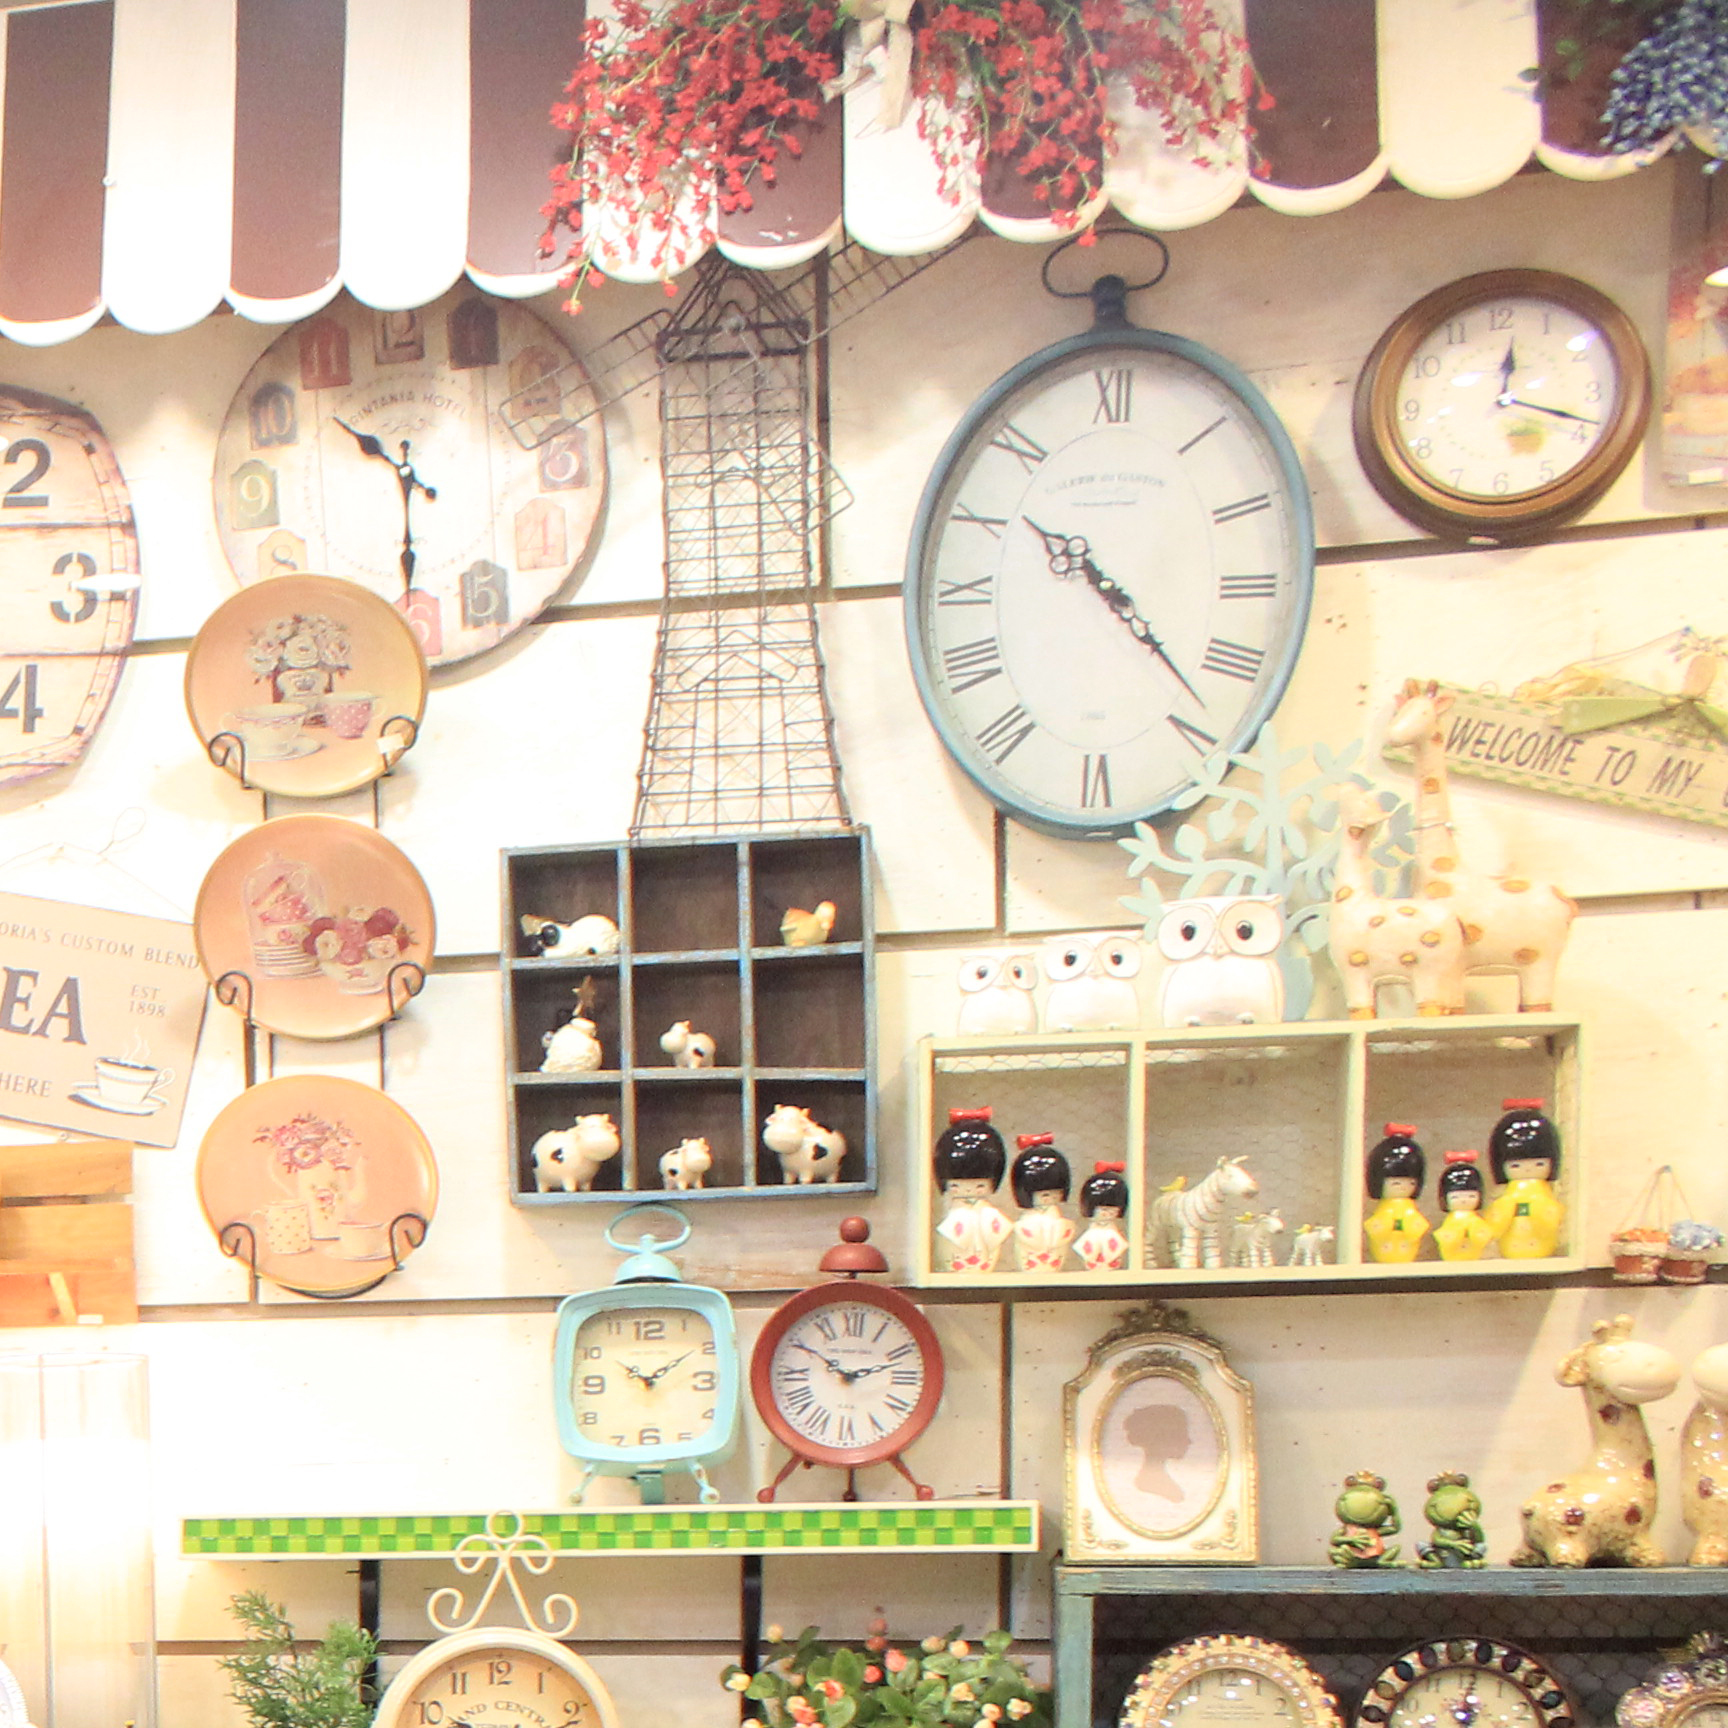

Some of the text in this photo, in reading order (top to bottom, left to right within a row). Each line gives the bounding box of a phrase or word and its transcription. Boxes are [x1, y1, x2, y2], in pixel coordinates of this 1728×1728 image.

[1487, 308, 1515, 331] 12
[1542, 313, 1551, 335] 1
[1446, 322, 1467, 344] 11
[311, 341, 339, 379] 11
[1414, 356, 1441, 379] 10
[1093, 369, 1133, 424] XII
[1585, 381, 1601, 403] 3
[257, 396, 292, 440] 10
[1405, 400, 1420, 421] 9
[1178, 417, 1227, 455] I
[1571, 423, 1588, 444] 4
[991, 423, 1048, 475] XI
[1416, 438, 1433, 459] 8
[545, 440, 580, 482] 3
[1539, 460, 1554, 482] 5
[2, 439, 52, 508] 2
[1449, 468, 1465, 489] 7
[1493, 472, 1509, 495] 6
[241, 475, 270, 517] 9
[951, 503, 1008, 538] X
[1212, 493, 1271, 524] II
[521, 513, 558, 557] 4
[50, 552, 97, 623] 3
[468, 573, 499, 617] 5
[937, 575, 993, 607] IX
[1219, 574, 1277, 599] III
[943, 637, 1002, 694] VIII
[1201, 637, 1266, 683] IIII
[976, 704, 1036, 765] VII
[1167, 714, 1218, 757] V
[1444, 716, 1704, 799] WELCOME TO MY
[1081, 754, 1112, 808] VI
[60, 932, 135, 958] CUSTOM
[144, 946, 200, 970] BLEND
[128, 1001, 166, 1018] 1898
[606, 1319, 622, 1336] 11
[633, 1320, 666, 1341] 12
[681, 1318, 688, 1332] 1
[583, 1346, 603, 1361] 10
[701, 1342, 716, 1355] 2
[582, 1375, 606, 1395] 9
[692, 1370, 716, 1392] 3
[580, 1412, 598, 1426] 8
[701, 1408, 715, 1422] 4
[611, 1435, 626, 1447] 7
[638, 1428, 662, 1446] 6
[451, 1671, 468, 1695] 11
[487, 1660, 512, 1686] 12
[538, 1672, 544, 1694] 1
[419, 1700, 444, 1725] 10
[563, 1700, 581, 1725] 2
